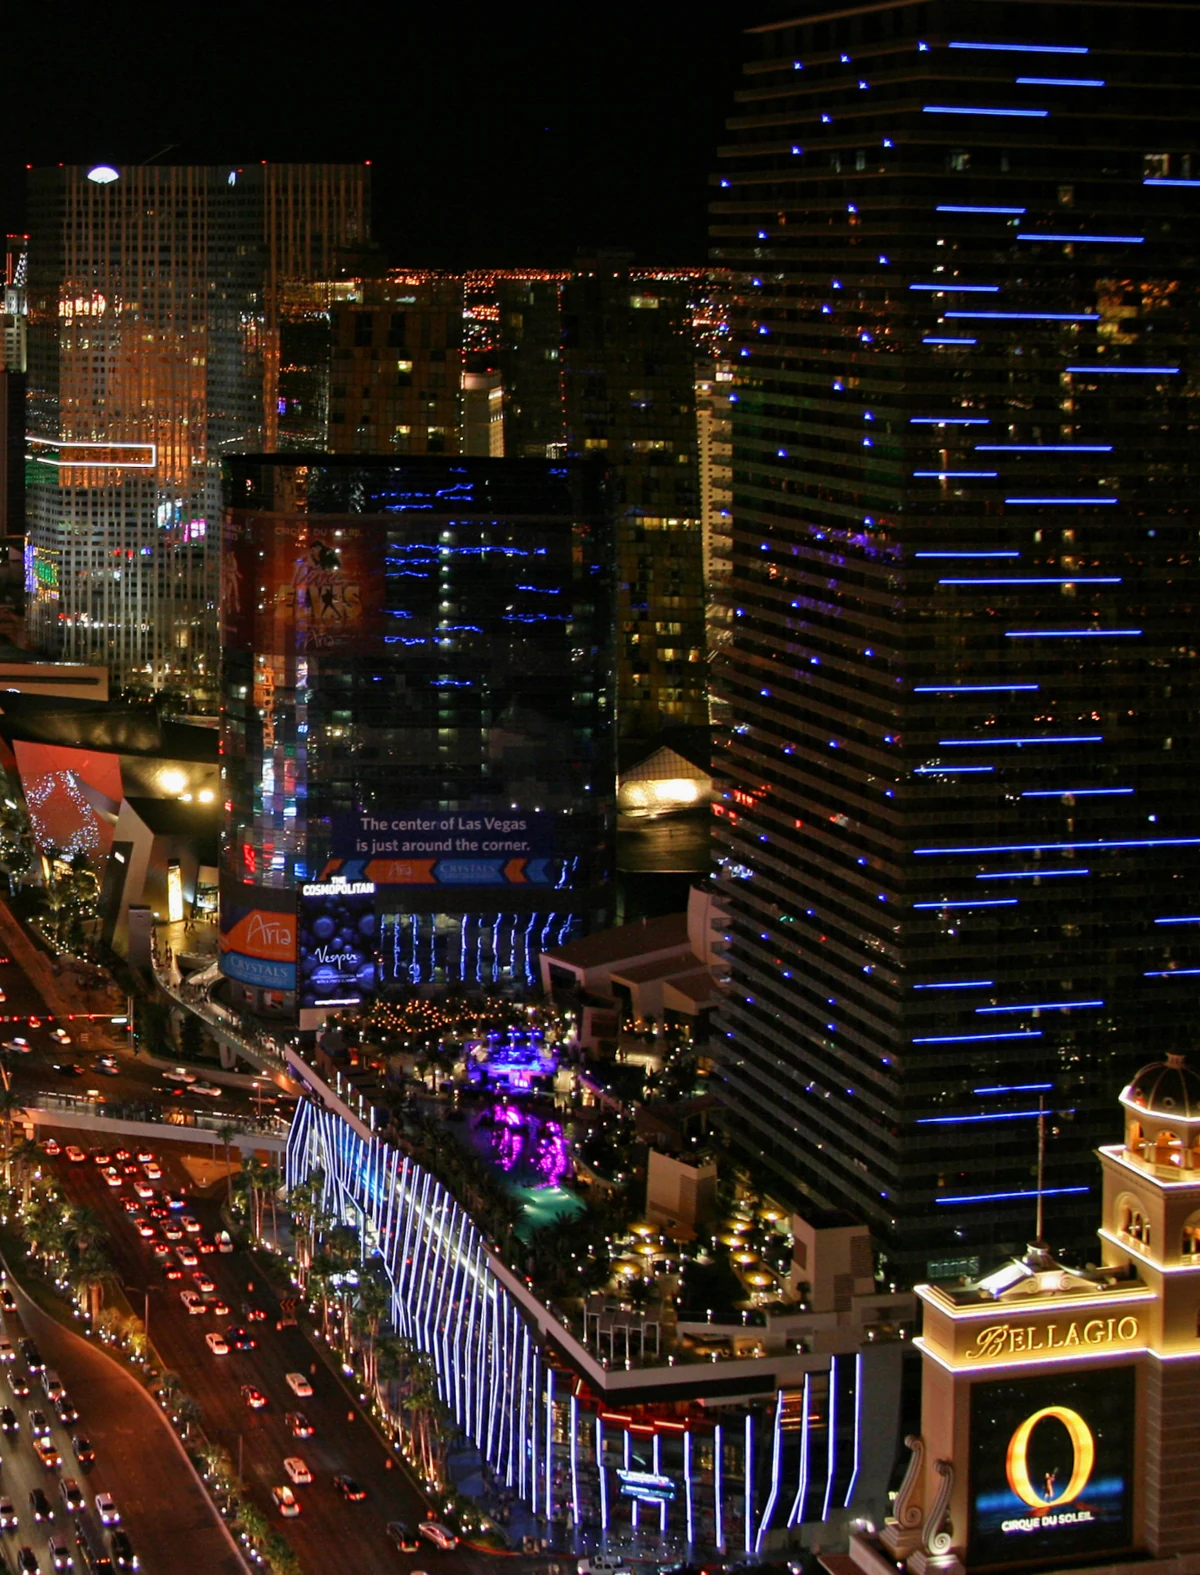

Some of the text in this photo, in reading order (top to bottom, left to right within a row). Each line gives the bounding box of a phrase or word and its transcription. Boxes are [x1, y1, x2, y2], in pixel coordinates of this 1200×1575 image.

[304, 629, 335, 648] Aria
[360, 817, 527, 833] The center of Las Vegas
[356, 839, 531, 854] is just around the corner.
[440, 864, 495, 873] CRYSTALS
[303, 883, 375, 896] COSMOPOLITAN
[331, 876, 347, 885] THE
[247, 914, 291, 945] Aria
[230, 955, 288, 978] CRYSTALS
[314, 945, 358, 970] Vesper
[965, 1316, 1139, 1360] BELLAGIO
[1005, 1406, 1095, 1508] O
[1001, 1511, 1095, 1533] CIRQUE DU SOLEIL
